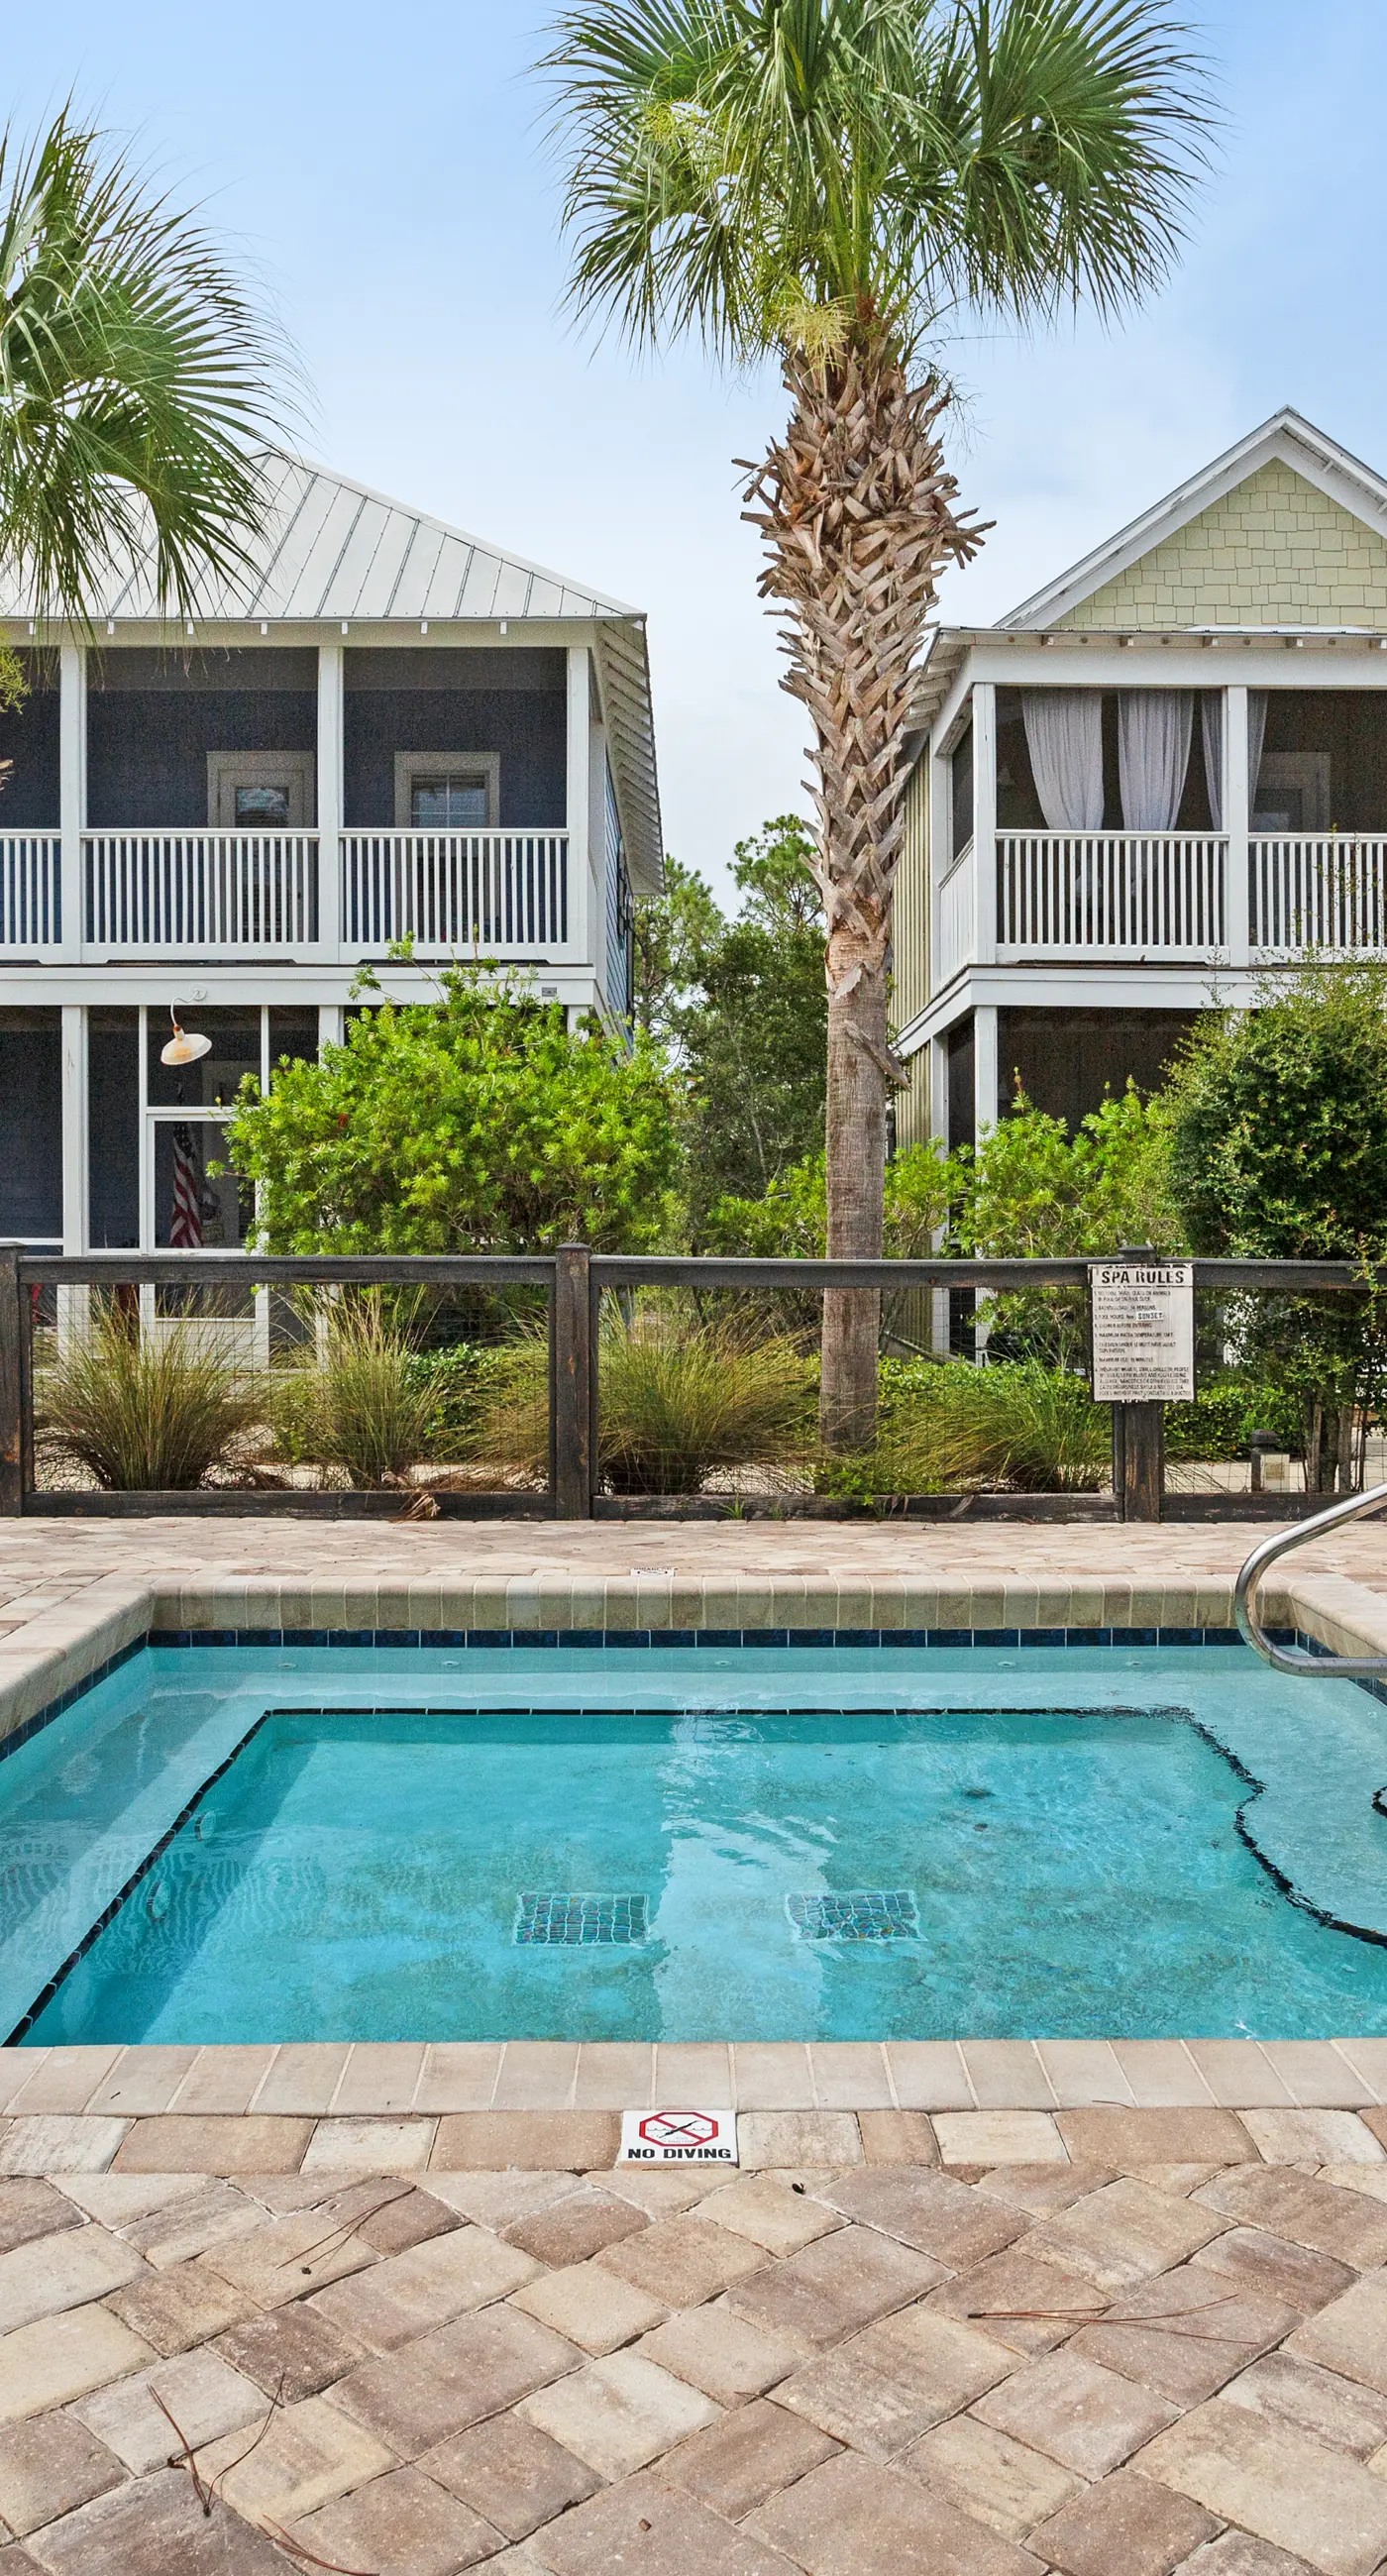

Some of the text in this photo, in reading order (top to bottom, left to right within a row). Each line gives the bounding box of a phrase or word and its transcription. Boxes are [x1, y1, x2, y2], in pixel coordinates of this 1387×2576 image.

[1102, 1270, 1184, 1284] SPA RULES
[627, 2148, 731, 2159] NO DIVING
